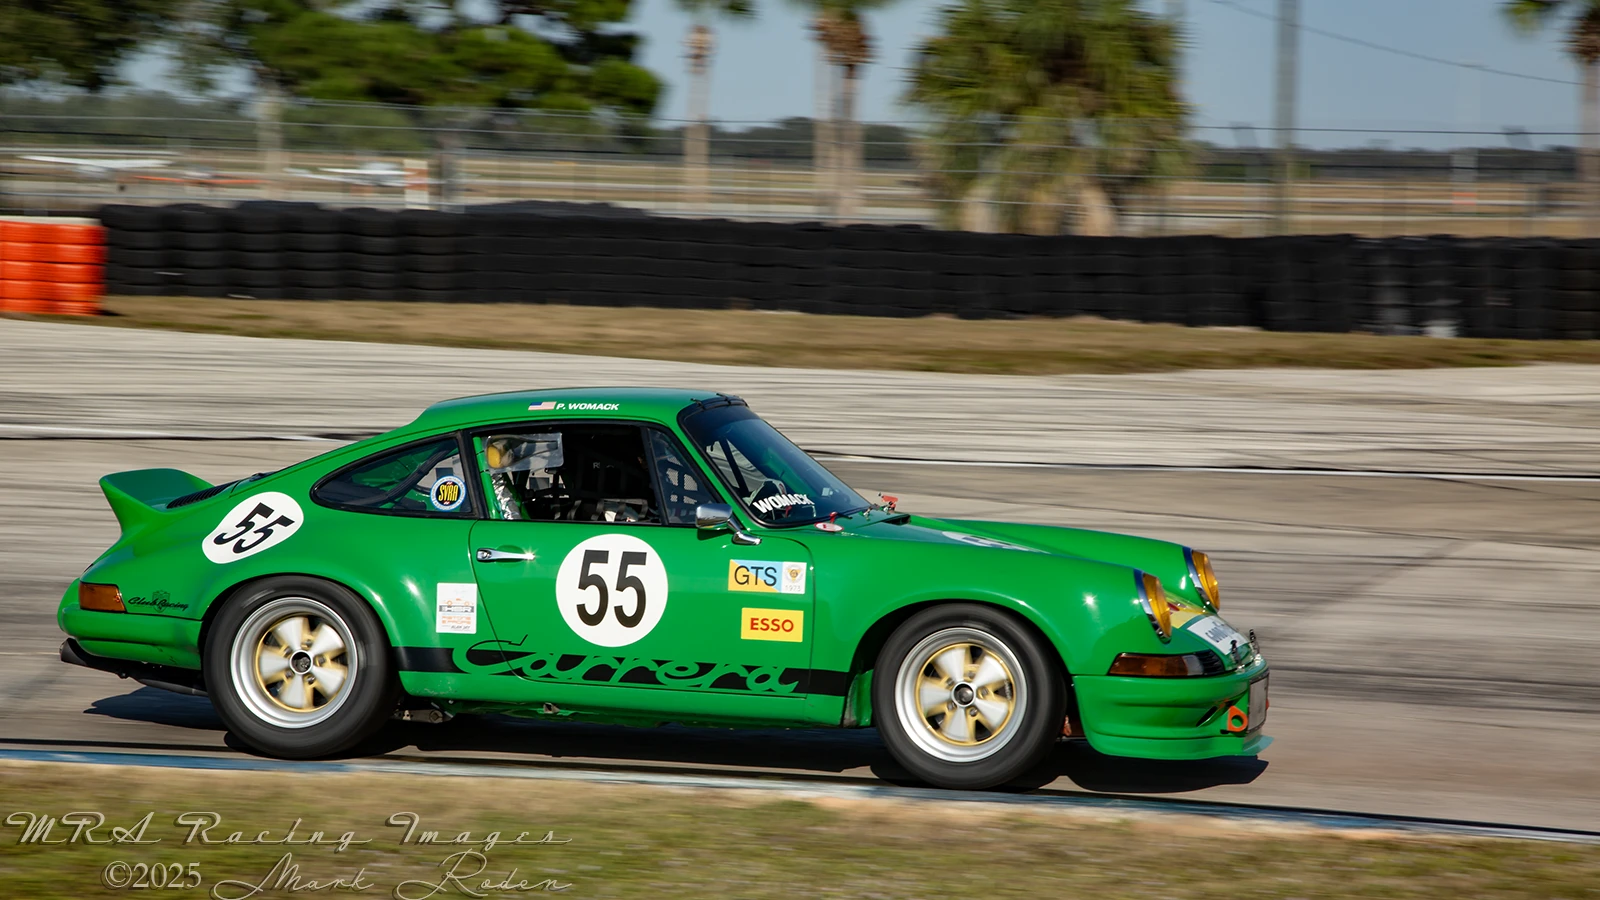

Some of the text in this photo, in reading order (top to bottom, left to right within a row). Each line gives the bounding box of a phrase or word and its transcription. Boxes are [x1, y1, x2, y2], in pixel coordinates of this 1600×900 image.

[568, 403, 620, 411] WOMACK
[438, 484, 459, 502] SVRA
[752, 493, 816, 514] WOMACK
[213, 502, 295, 554] 55
[734, 565, 777, 587] GTS
[576, 549, 647, 628] 55
[750, 617, 794, 633] ESSO
[451, 634, 800, 694] Carrera
